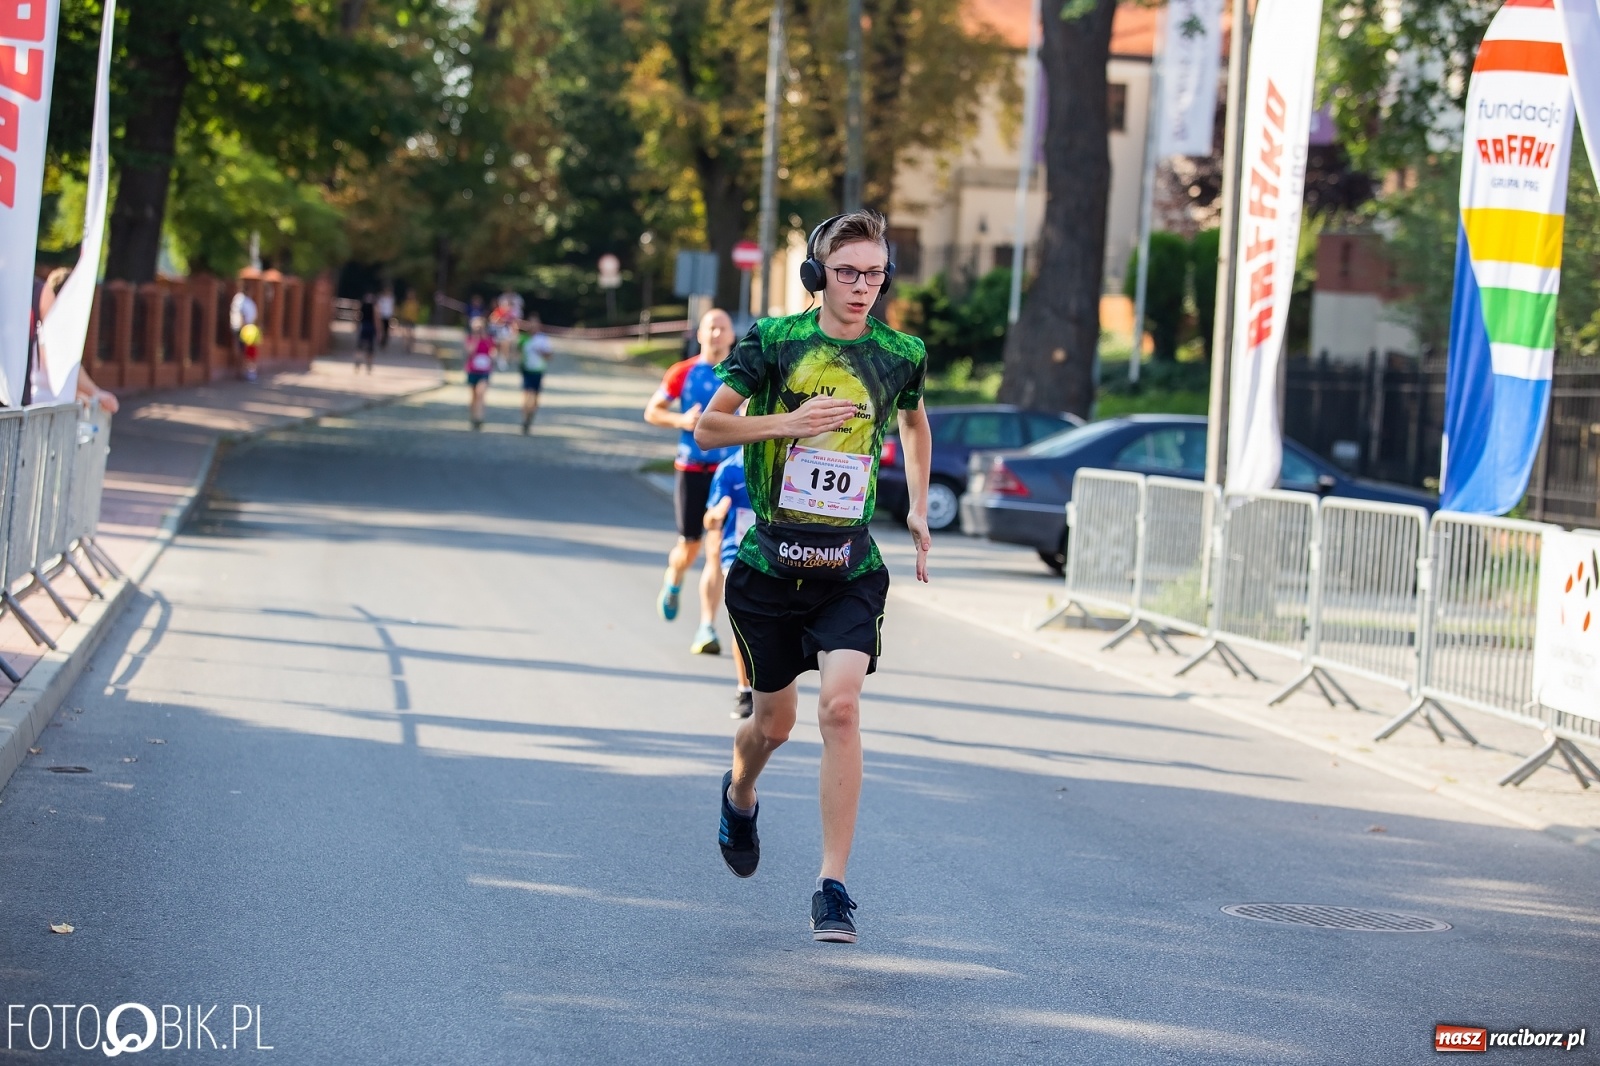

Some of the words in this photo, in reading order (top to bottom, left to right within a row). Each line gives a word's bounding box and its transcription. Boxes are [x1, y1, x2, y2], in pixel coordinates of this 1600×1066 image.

[1245, 77, 1287, 353] RAFAKO
[820, 386, 837, 397] IV
[810, 467, 851, 494] 130
[779, 541, 844, 562] GÓRNIK
[803, 553, 844, 569] Zabrze
